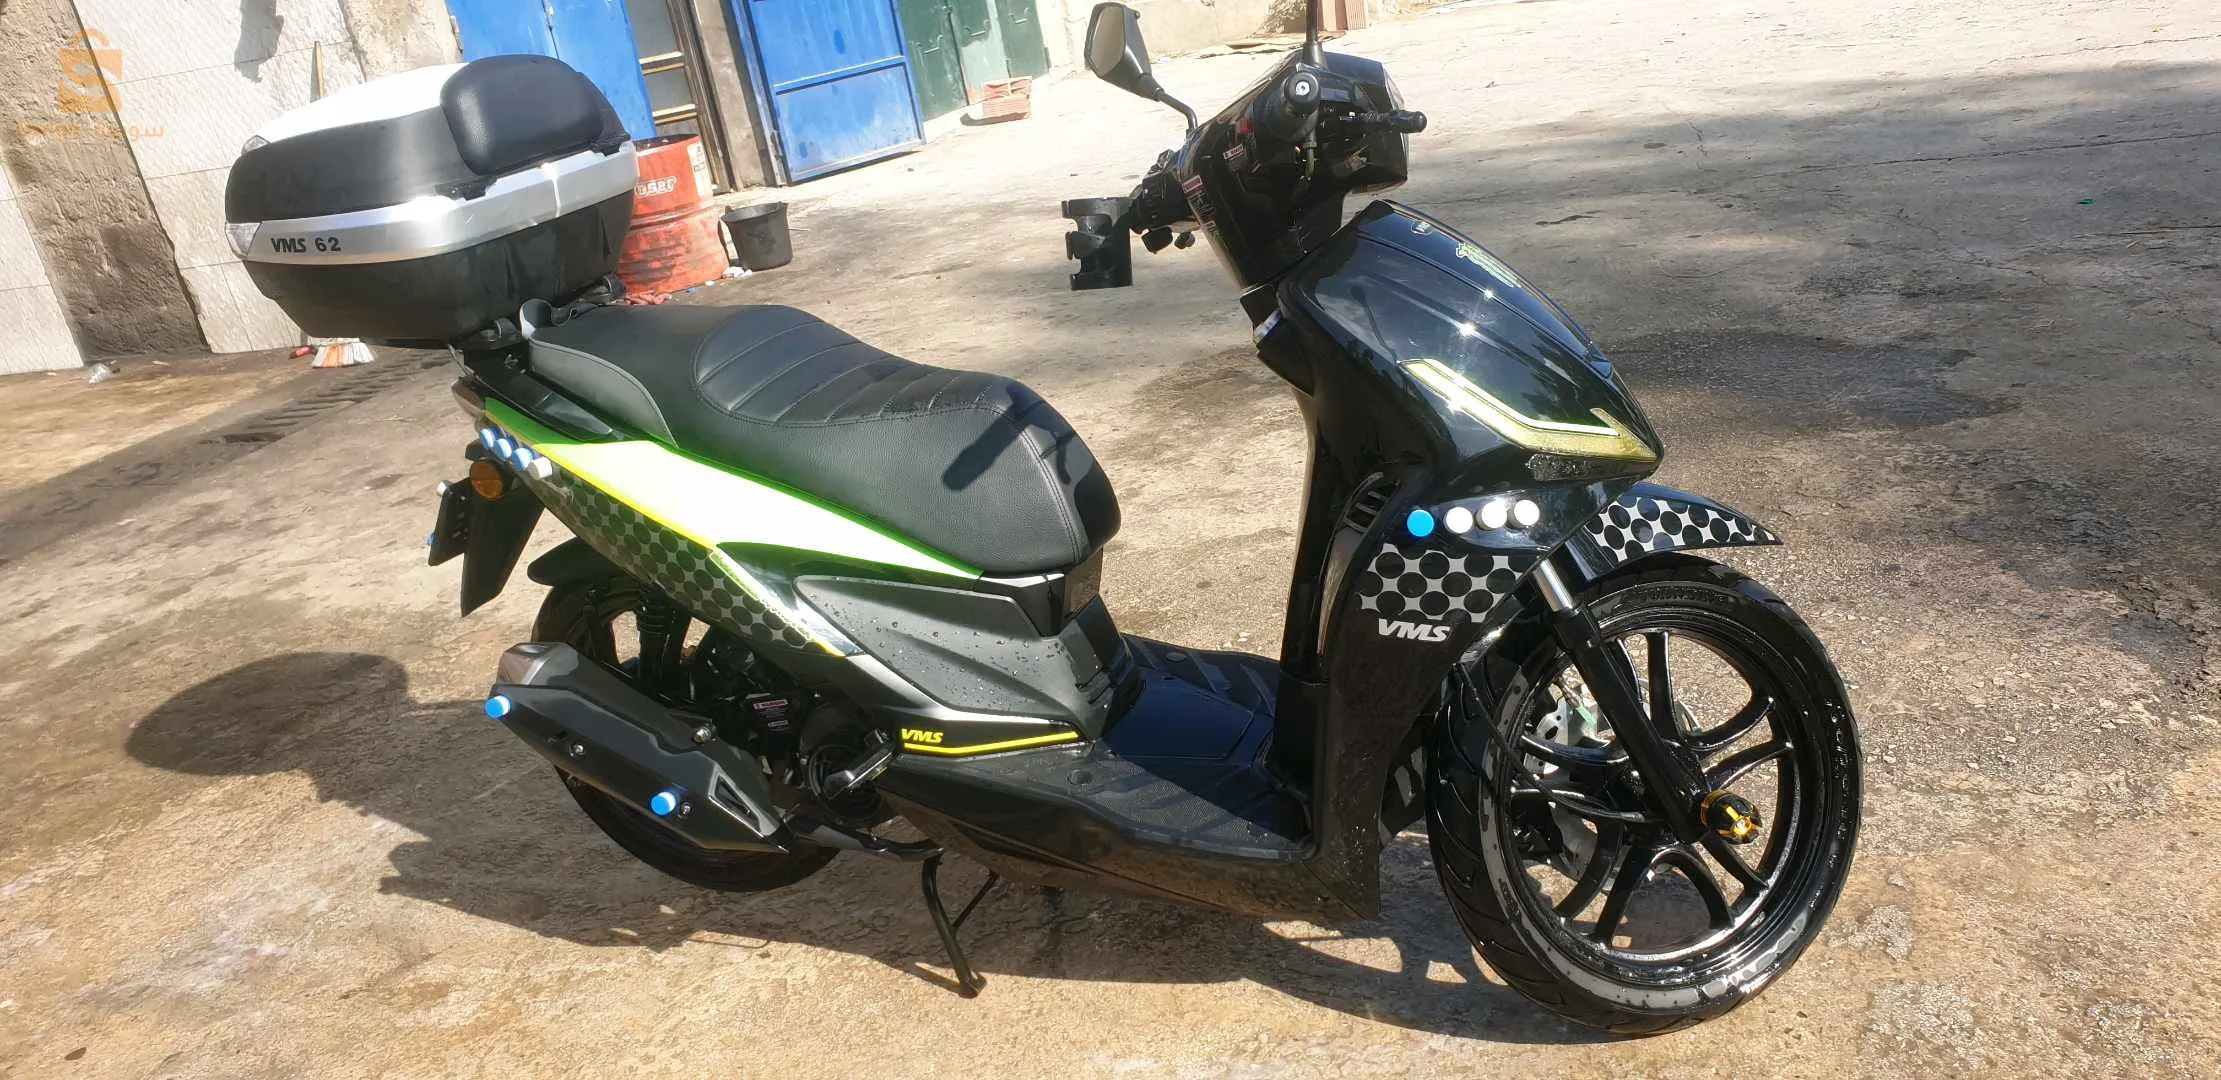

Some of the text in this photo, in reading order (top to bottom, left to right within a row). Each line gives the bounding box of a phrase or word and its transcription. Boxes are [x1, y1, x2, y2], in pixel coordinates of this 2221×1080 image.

[270, 236, 342, 253] VMS 62
[1378, 618, 1451, 642] VMS
[901, 728, 944, 743] VMS
